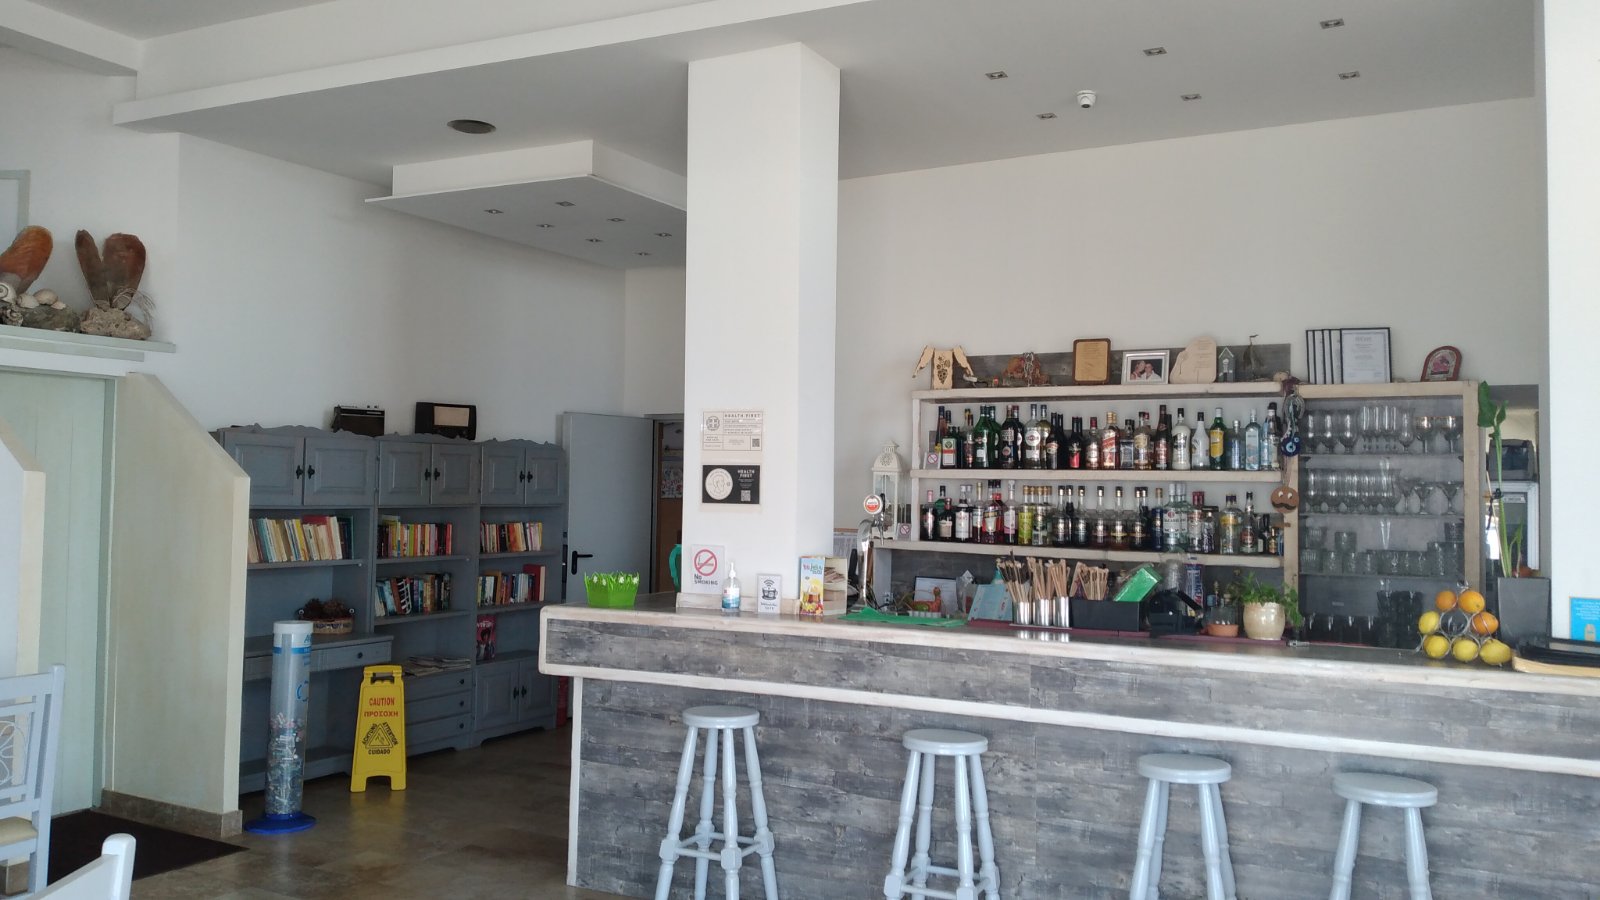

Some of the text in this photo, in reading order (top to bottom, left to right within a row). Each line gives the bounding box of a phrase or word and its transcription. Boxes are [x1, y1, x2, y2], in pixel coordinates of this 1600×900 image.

[369, 697, 395, 706] CAUTION
[362, 723, 378, 745] ACHTUNG
[382, 721, 398, 745] ATTENTION
